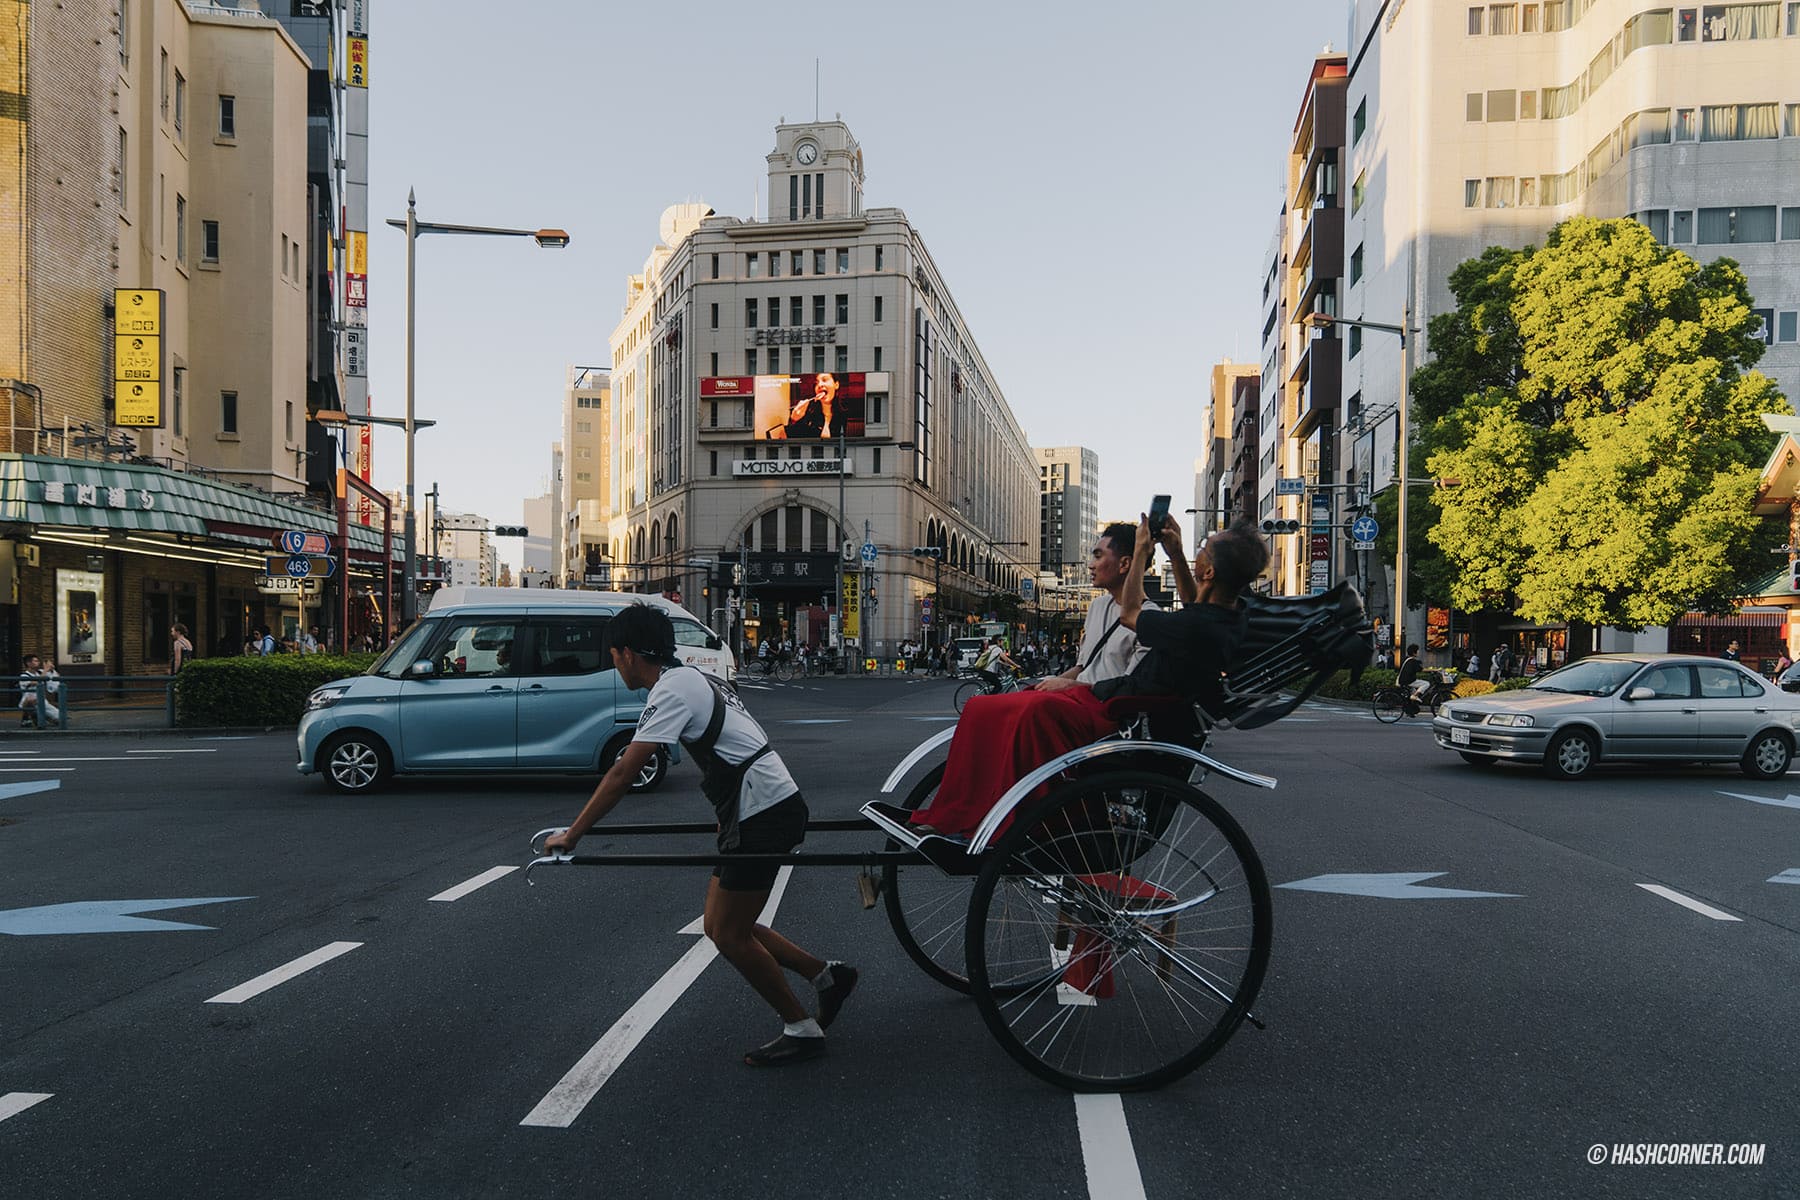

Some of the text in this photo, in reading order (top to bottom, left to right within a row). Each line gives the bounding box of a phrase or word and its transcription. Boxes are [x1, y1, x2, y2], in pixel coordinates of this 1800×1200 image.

[348, 298, 366, 306] KFC
[756, 326, 836, 346] EKIMISE
[120, 357, 154, 368] レストラン
[293, 534, 301, 548] 6
[288, 560, 309, 573] 463
[748, 562, 809, 576] 浅草駅
